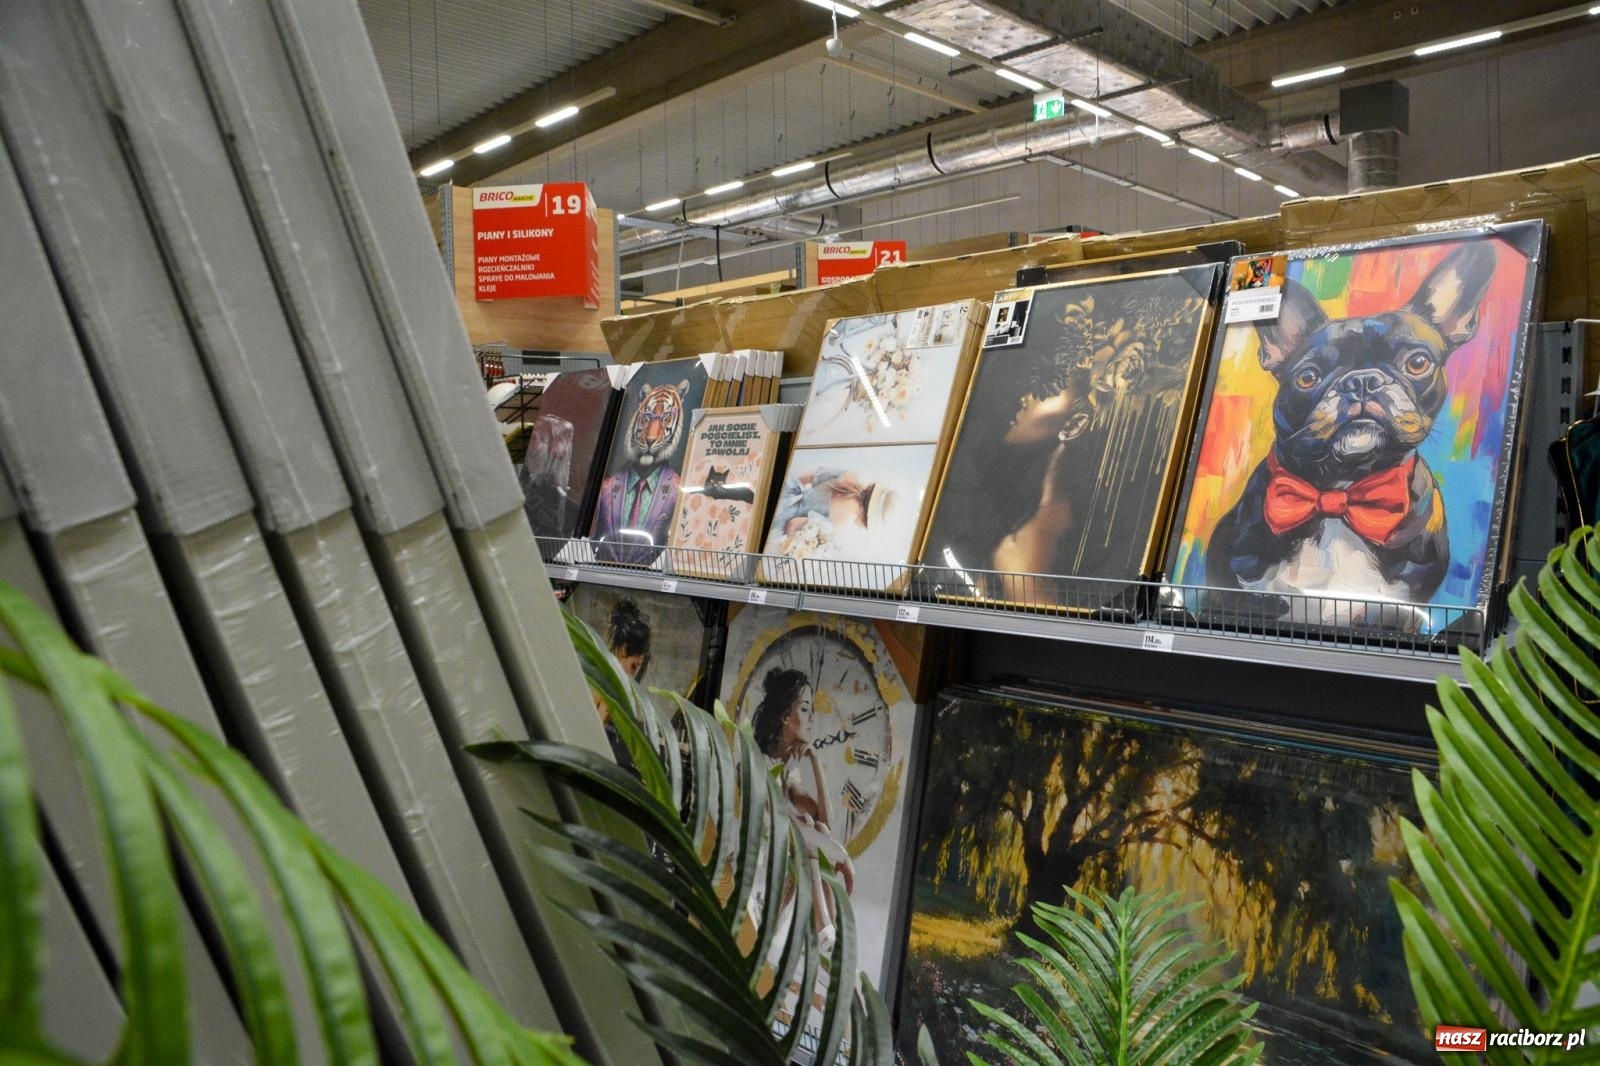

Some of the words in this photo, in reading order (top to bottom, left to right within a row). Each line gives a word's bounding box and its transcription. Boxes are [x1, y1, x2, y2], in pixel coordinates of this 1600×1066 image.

[479, 191, 514, 202] BRICO
[552, 195, 582, 215] 19
[477, 230, 506, 241] PIANY
[507, 230, 511, 239] I
[512, 228, 554, 239] SILIKONY
[823, 246, 850, 254] BRICO
[880, 250, 902, 264] 21
[478, 274, 503, 283] SPRAYE
[515, 272, 555, 281] MALOWANIA
[478, 285, 497, 293] KLEJE
[708, 424, 725, 432] JAK
[726, 423, 757, 431] SOBIE
[710, 440, 722, 448] TO
[724, 440, 748, 448] MNIE
